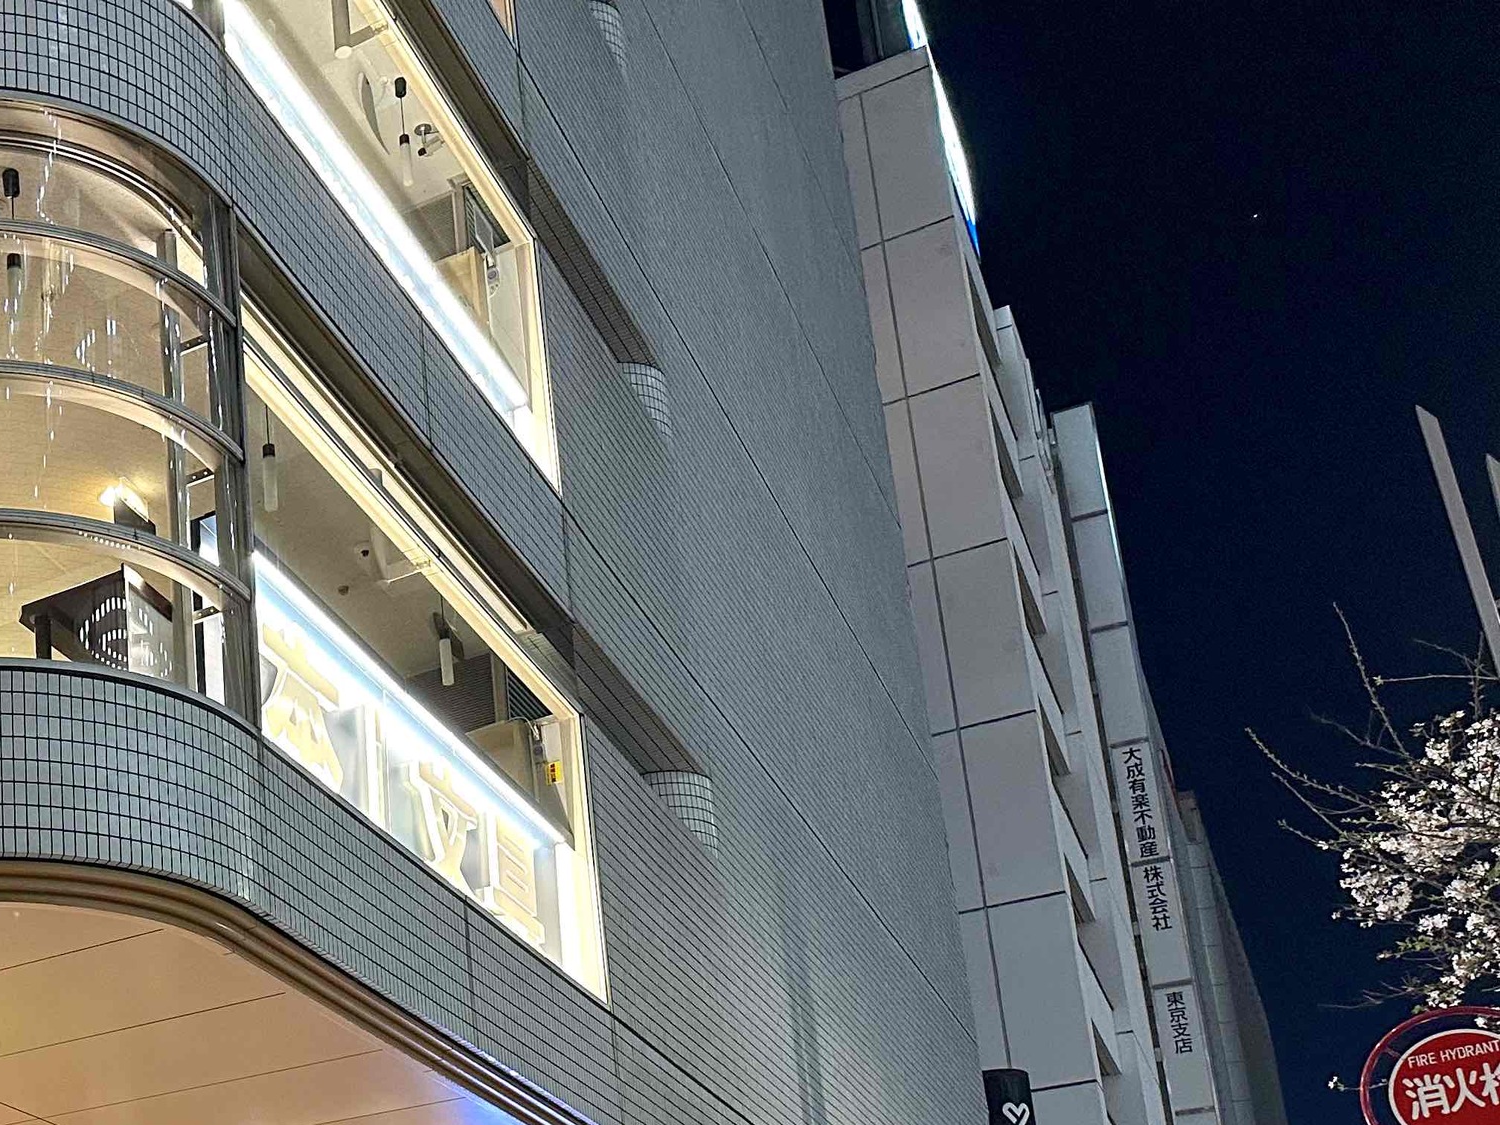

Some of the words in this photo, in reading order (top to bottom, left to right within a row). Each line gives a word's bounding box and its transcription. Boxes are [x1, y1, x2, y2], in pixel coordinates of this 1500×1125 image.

[1122, 747, 1160, 858] 大成有楽不動産
[1143, 865, 1173, 932] 株式会社
[1166, 991, 1193, 1054] 東京支店
[1407, 1052, 1438, 1069] FIRE
[1439, 1040, 1500, 1063] HYDRANT
